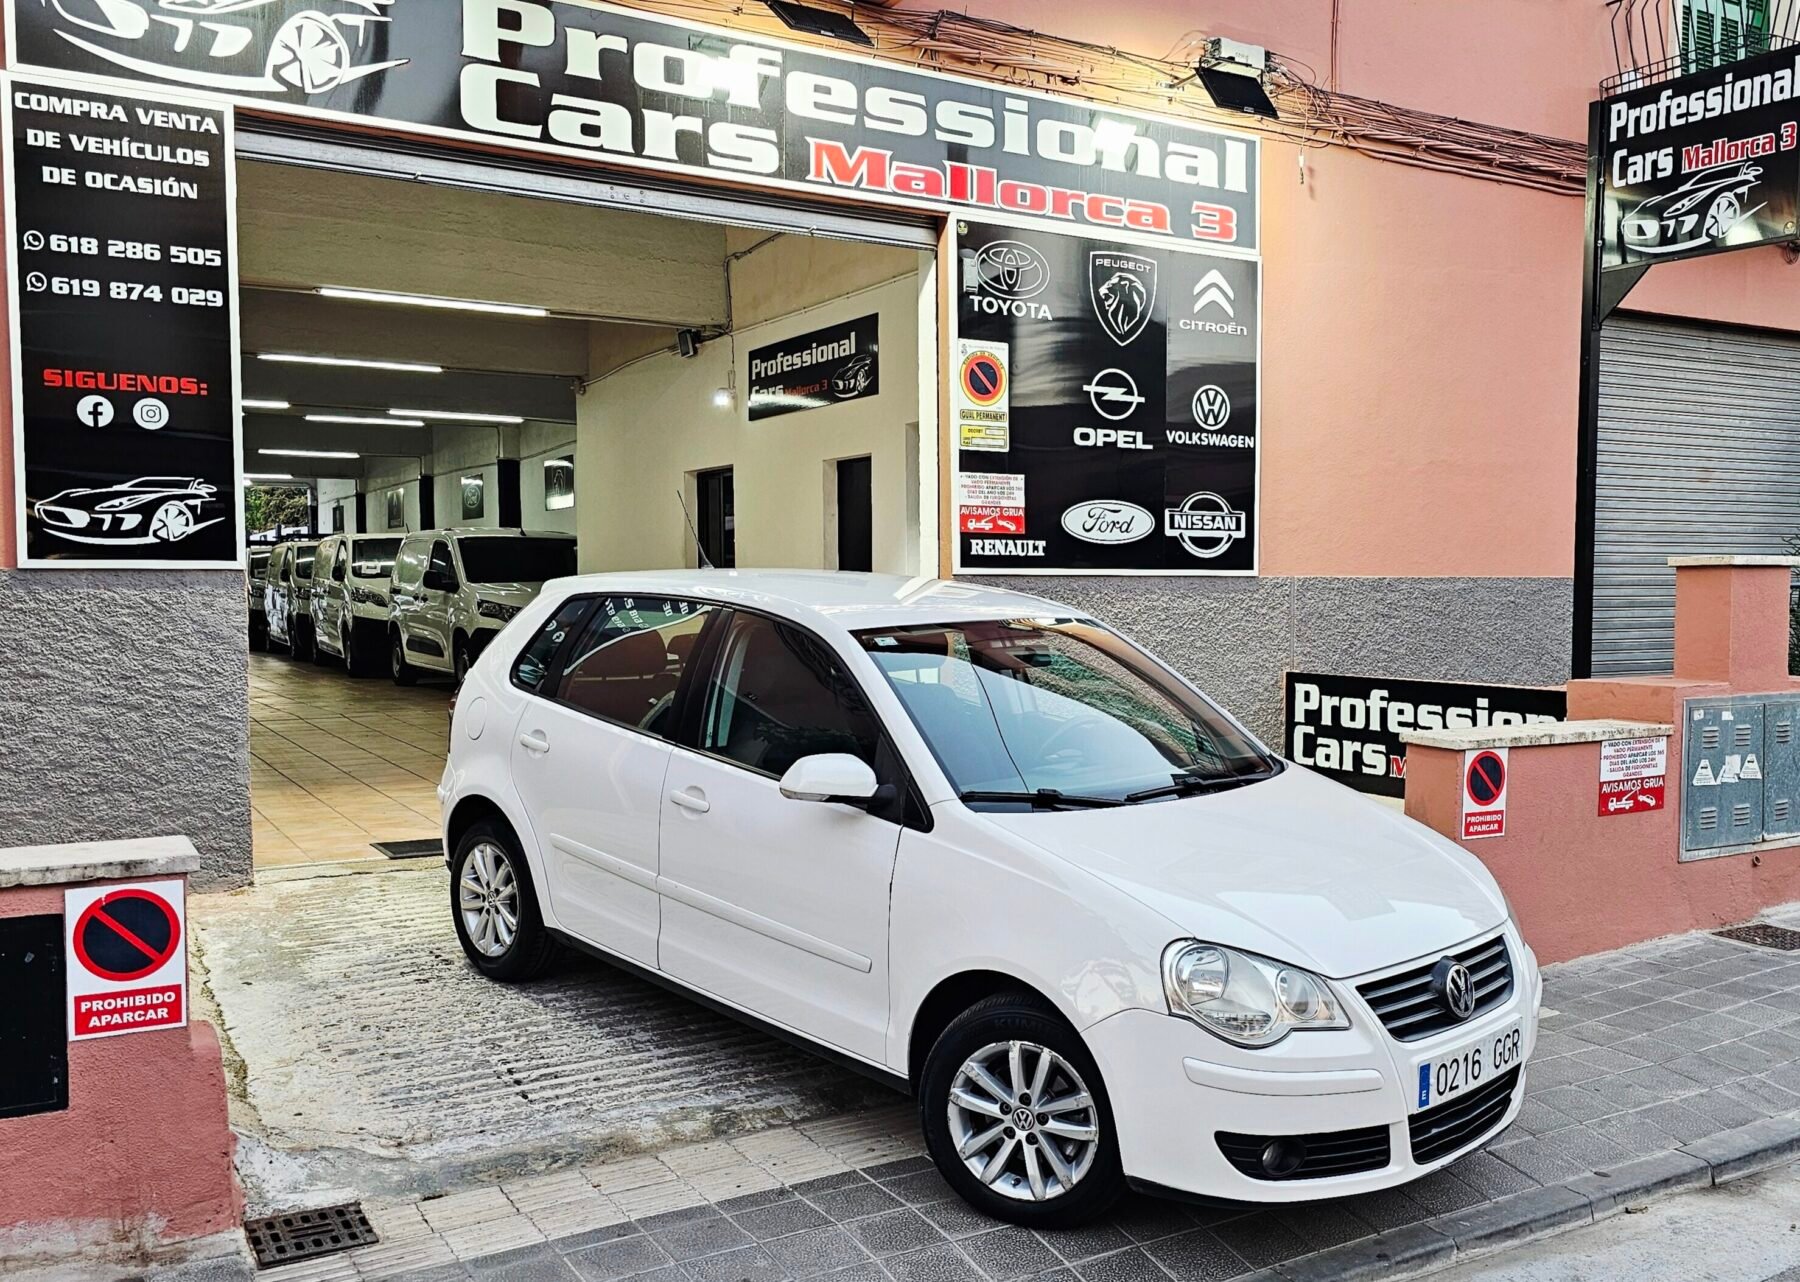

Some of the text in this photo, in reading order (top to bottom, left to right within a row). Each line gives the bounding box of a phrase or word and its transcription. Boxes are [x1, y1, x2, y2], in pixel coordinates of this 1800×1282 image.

[463, 0, 1248, 194] Professional
[14, 91, 219, 135] COMPRA VENTA
[26, 128, 210, 168] DE VEHÍCULOS
[460, 63, 1238, 244] Cars Mallorca 3
[1612, 121, 1797, 188] Cars Mallorca 3
[42, 165, 198, 199] DE OCASIÓN
[49, 233, 221, 267] 618 286 505
[1095, 258, 1152, 273] PEUGEOT
[51, 276, 223, 307] 619 874 029
[970, 295, 1052, 321] TOYOTA
[752, 332, 856, 380] Professional
[43, 369, 207, 395] SIGUENOS:
[822, 379, 828, 391] 3
[976, 411, 1006, 421] PERMANENT
[1074, 428, 1153, 450] OPEL
[1166, 430, 1254, 449] VOLKSWAGEN
[960, 506, 1024, 516] AVISAMOS GRUA
[1083, 506, 1135, 535] Ford
[1174, 514, 1236, 531] NISSAN
[970, 540, 1047, 557] RENAULT
[1294, 683, 1567, 733] Profession
[1293, 725, 1387, 776] Cars
[1601, 777, 1664, 794] AVISAMOS GRUA
[1466, 814, 1502, 823] PROHIBIDO
[1469, 823, 1499, 832] APARCAR
[80, 991, 176, 1013] PROHIBIDO
[88, 1007, 169, 1028] APARCAR
[1436, 1028, 1520, 1096] 0216 GGR
